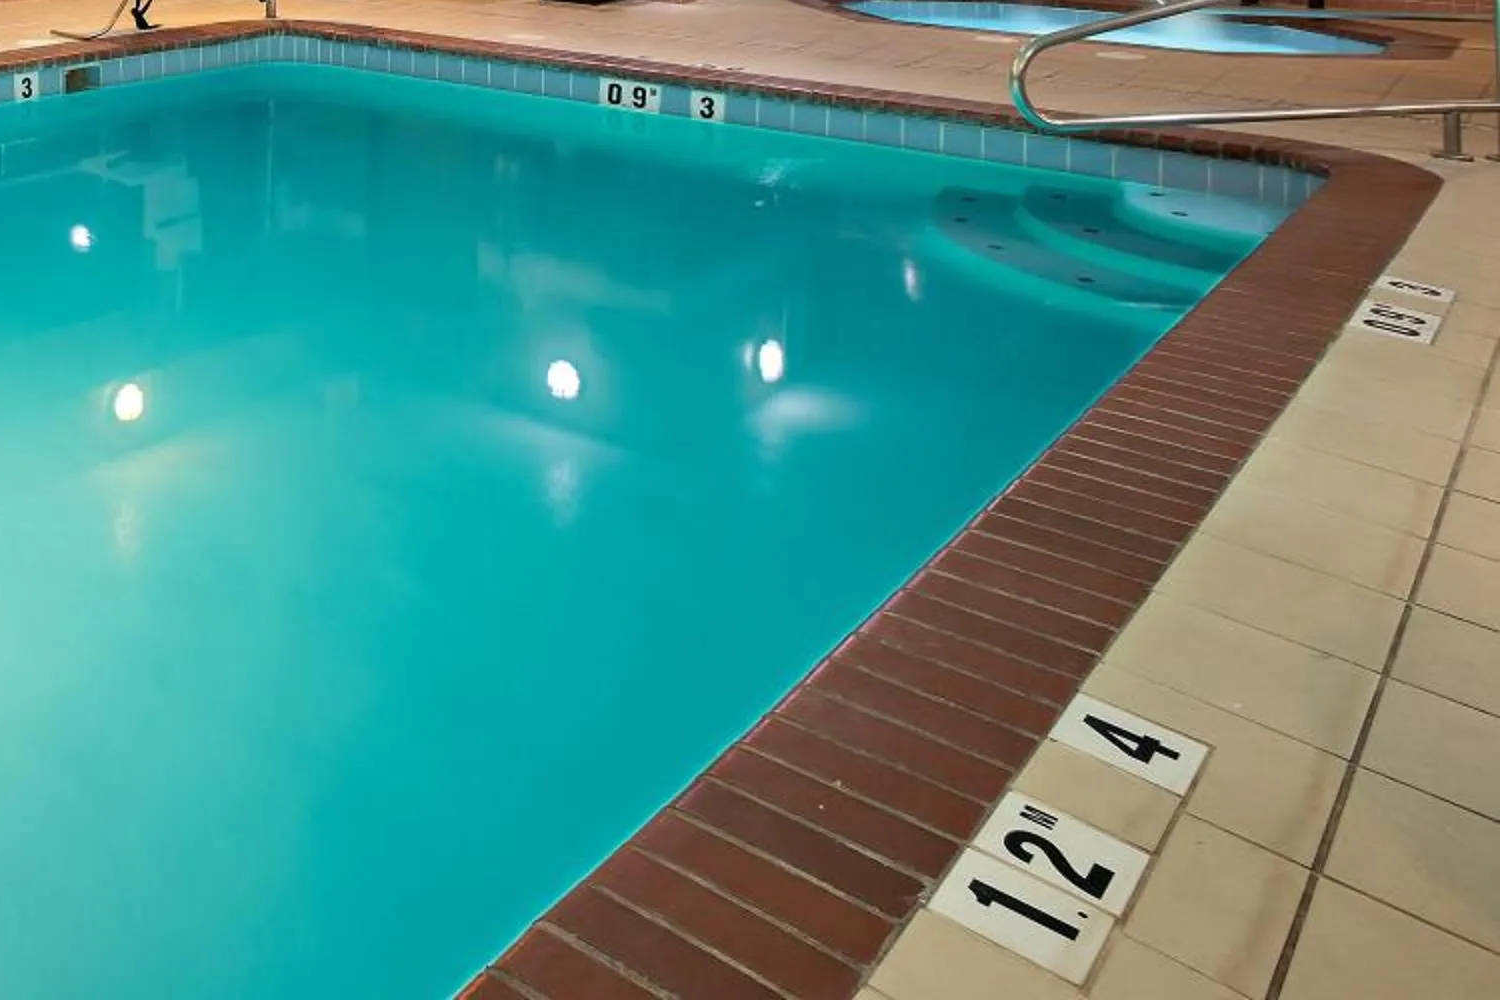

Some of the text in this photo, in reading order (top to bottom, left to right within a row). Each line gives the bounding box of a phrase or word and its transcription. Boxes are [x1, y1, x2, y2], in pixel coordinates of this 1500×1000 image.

[21, 77, 33, 99] 3
[699, 96, 715, 119] 3
[967, 713, 1181, 941] 1.2M 4
